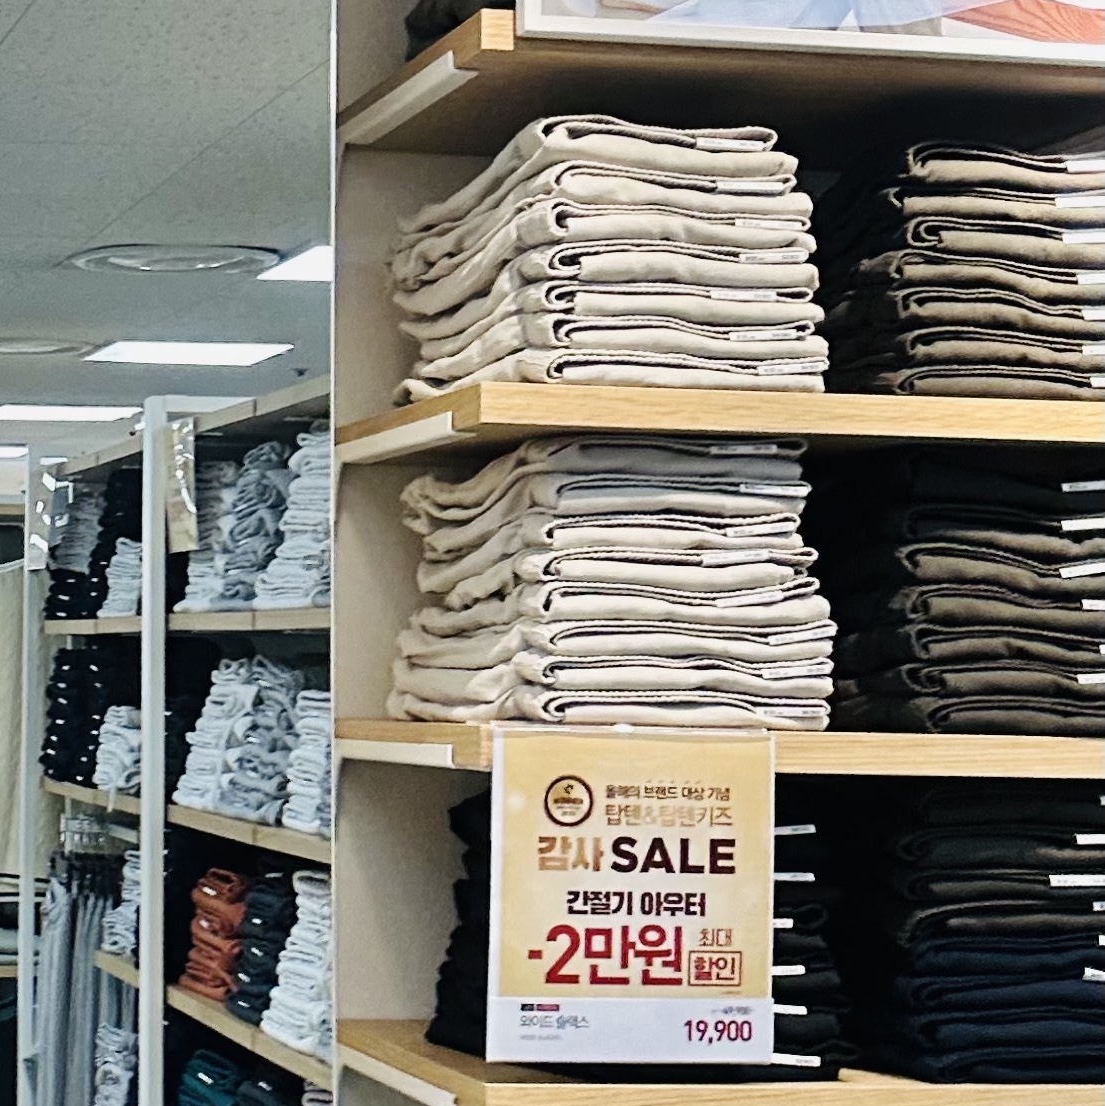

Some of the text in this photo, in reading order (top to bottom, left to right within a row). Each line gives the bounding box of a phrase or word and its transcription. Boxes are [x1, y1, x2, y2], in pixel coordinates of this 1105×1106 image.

[644, 785, 679, 800] 브랜드
[538, 836, 736, 874] 감사 SALE
[566, 890, 706, 916] 간절기 아우터
[694, 957, 736, 981] 할인
[684, 1019, 752, 1045] 19,900
